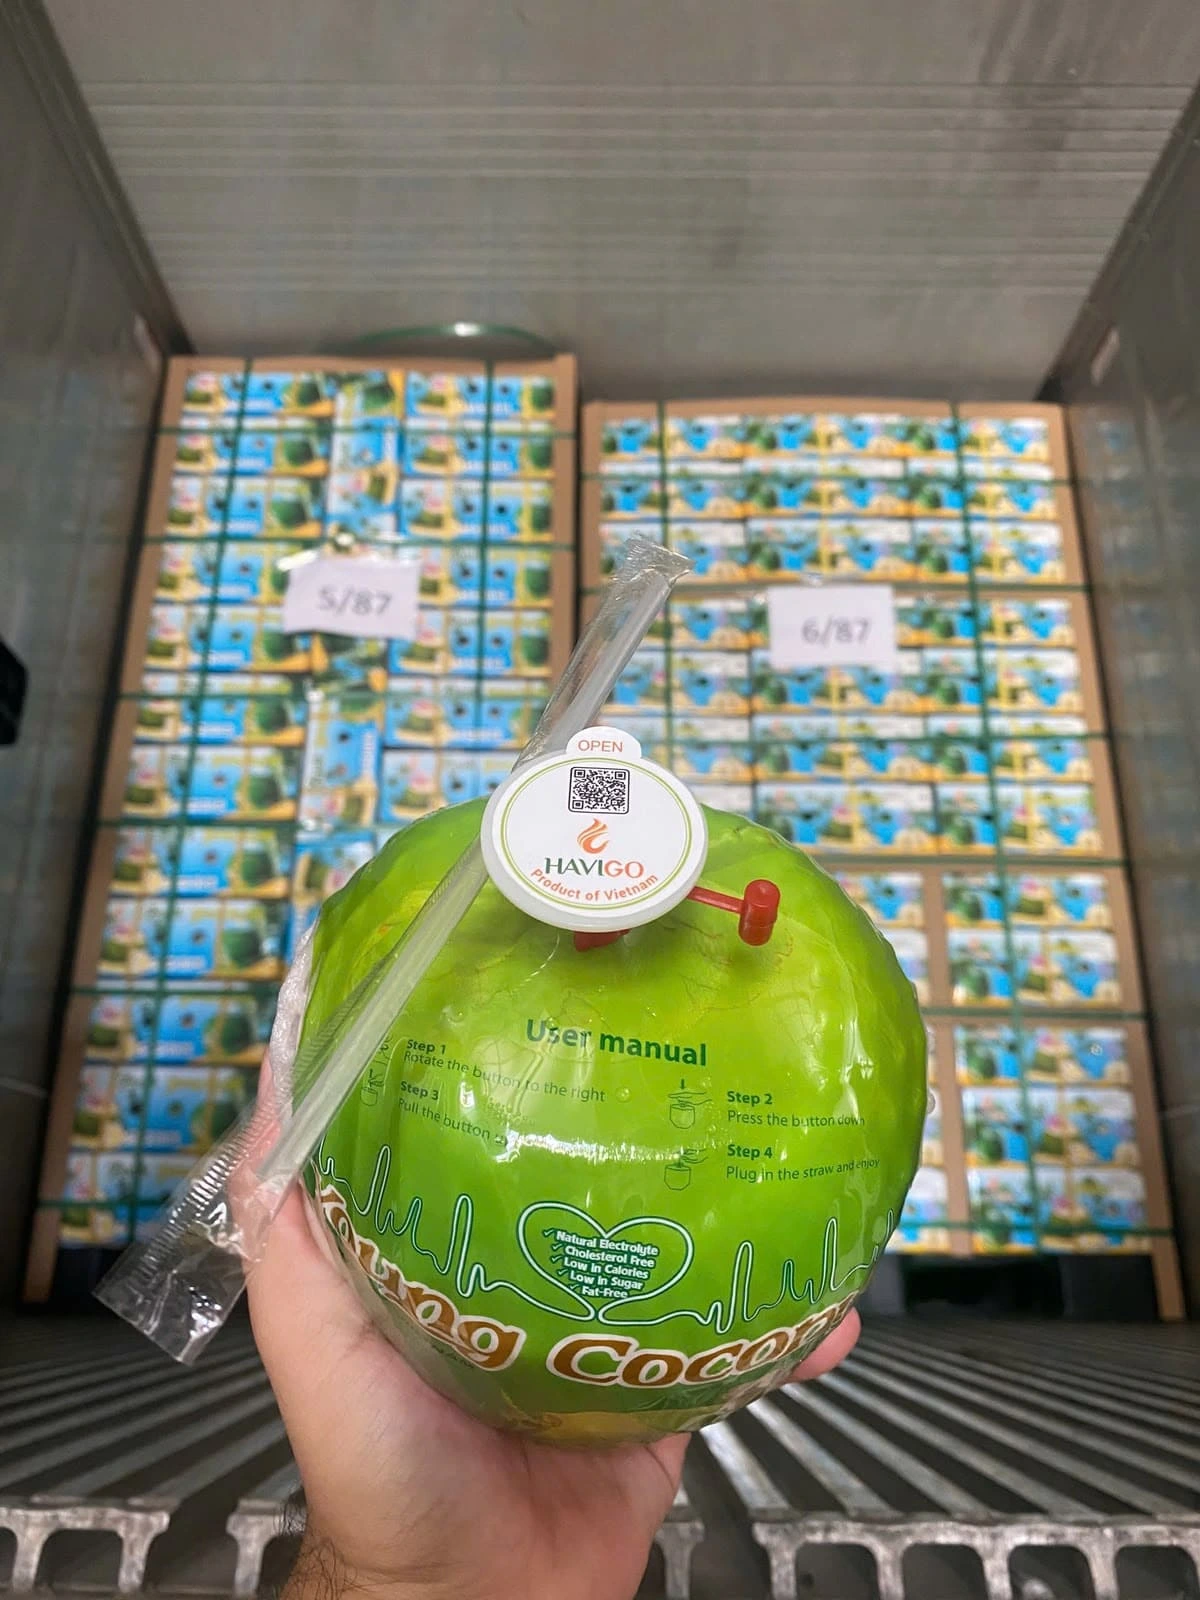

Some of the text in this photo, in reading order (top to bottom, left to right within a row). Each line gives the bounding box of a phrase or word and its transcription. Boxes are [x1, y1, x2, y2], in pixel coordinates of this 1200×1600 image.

[319, 584, 392, 616] 5/87
[801, 613, 871, 648] 6/87
[577, 739, 623, 753] OPEN
[545, 857, 644, 879] HAVIGO
[531, 868, 659, 901] Product of Vietnam
[406, 1039, 446, 1055] Step 1
[526, 1018, 707, 1067] User manual
[403, 1050, 606, 1103] Rotate the button to the right
[400, 1080, 439, 1100] Step 3
[727, 1090, 773, 1107] Step 2
[398, 1097, 420, 1115] Pull
[421, 1107, 441, 1123] the
[443, 1115, 490, 1141] button
[727, 1109, 865, 1127] Press the button down
[727, 1143, 773, 1161] Step 4
[726, 1157, 880, 1183] Plug in the straw and enjoy
[556, 1230, 659, 1258] Natural Electrolyte
[563, 1256, 649, 1280] Low in Calories
[564, 1244, 655, 1269] Cholesterol Free
[570, 1270, 643, 1292] Low in Sugar
[581, 1285, 628, 1300] Fat-Free
